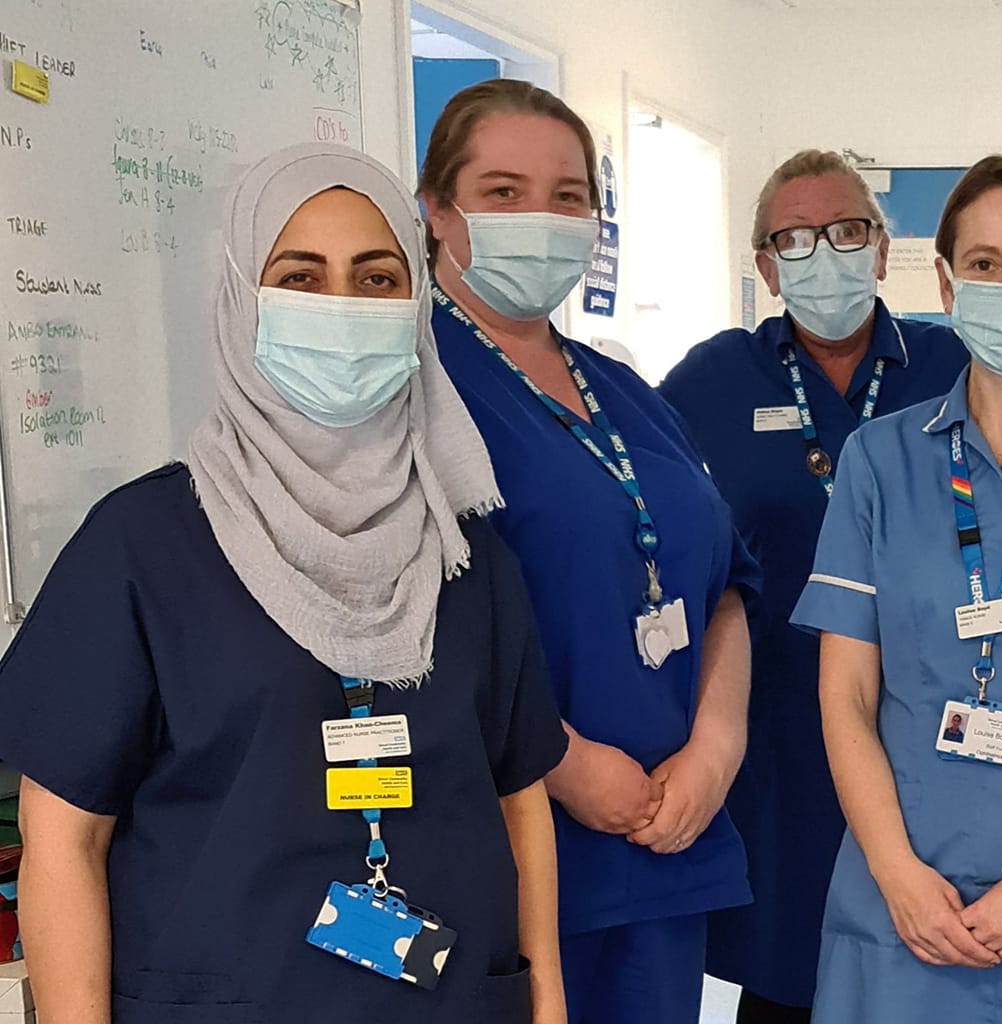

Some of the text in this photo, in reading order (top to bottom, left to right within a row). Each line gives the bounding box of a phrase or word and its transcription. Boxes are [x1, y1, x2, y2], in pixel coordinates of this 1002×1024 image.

[35, 51, 76, 77] LEADER
[7, 216, 48, 237] TRIAGE
[16, 269, 70, 295] Student
[794, 386, 807, 404] NHS
[868, 378, 880, 398] NHS
[584, 391, 601, 414] NHS
[862, 400, 875, 419] NHS
[800, 408, 812, 426] NHS
[609, 433, 636, 481] NHS NHS
[973, 728, 994, 738] Louise
